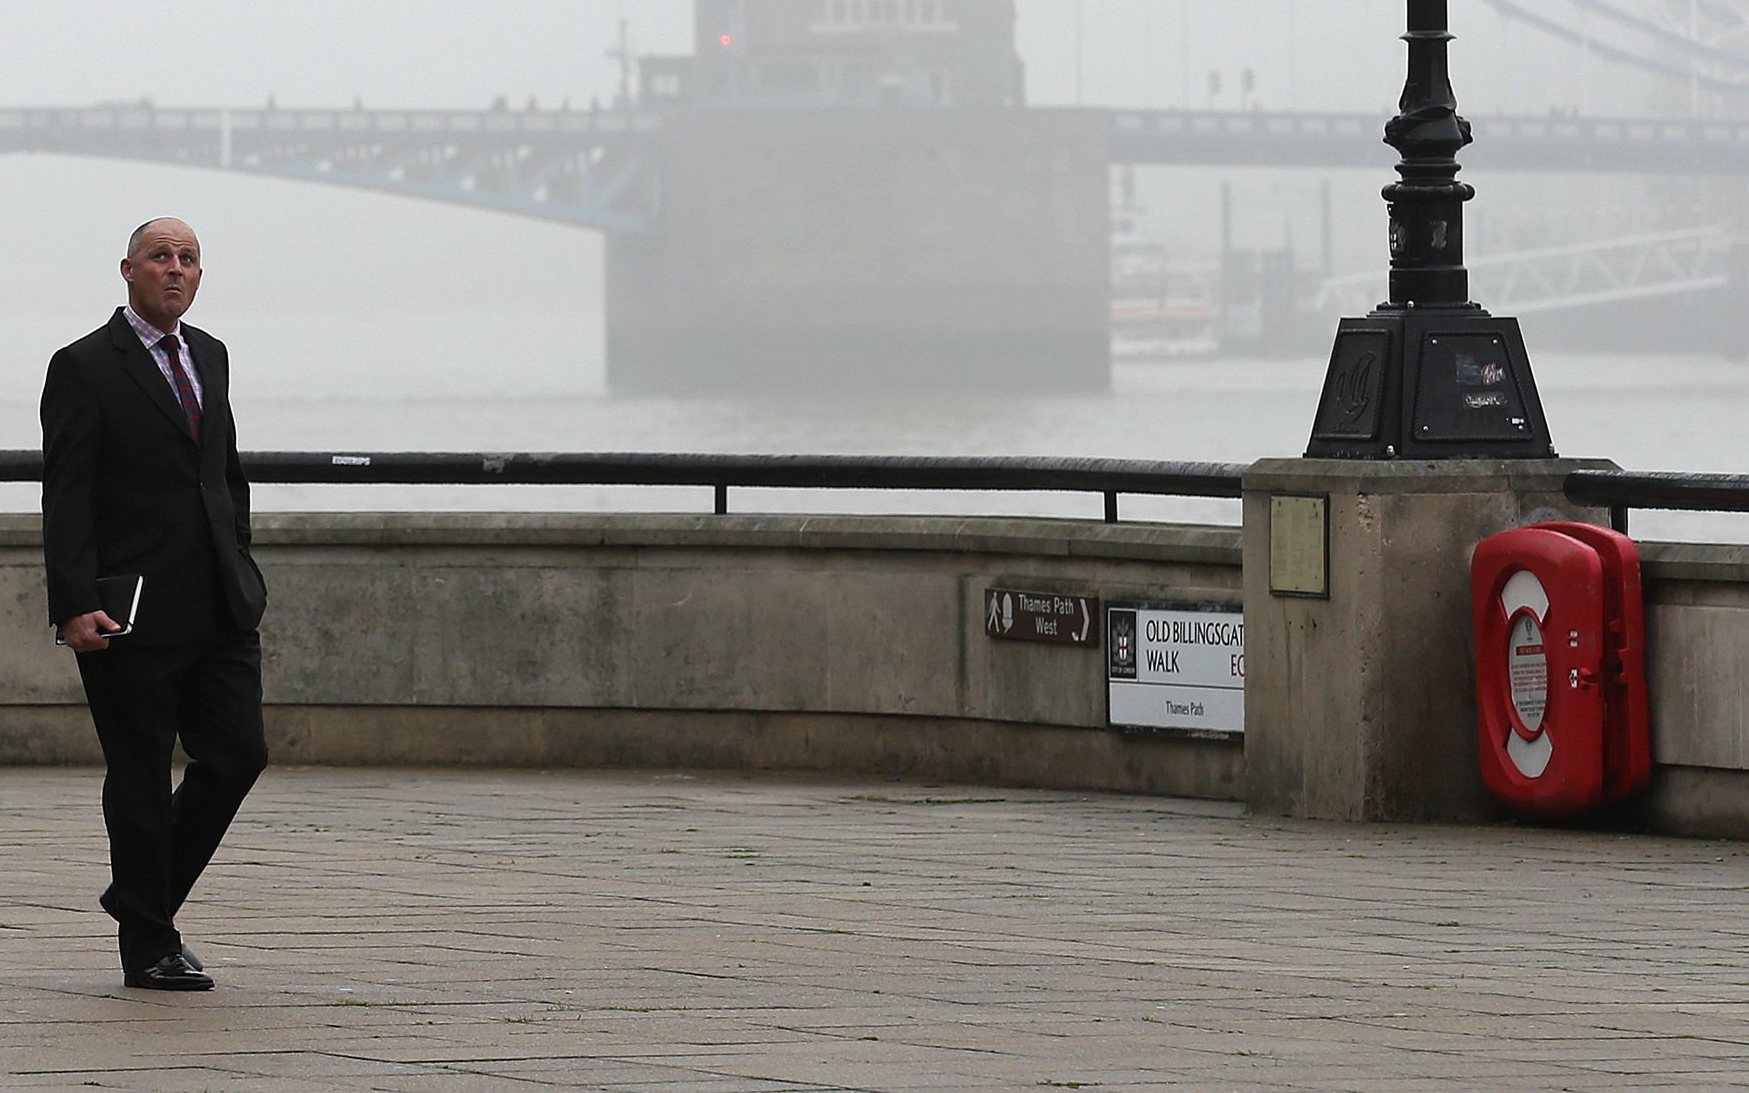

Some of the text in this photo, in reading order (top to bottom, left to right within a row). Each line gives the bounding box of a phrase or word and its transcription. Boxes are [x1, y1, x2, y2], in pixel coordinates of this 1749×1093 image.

[1019, 594, 1074, 615] Thames Path
[1035, 617, 1058, 635] West
[1146, 619, 1171, 643] OLD
[1146, 649, 1180, 674] WALK
[1166, 701, 1204, 716] Thames Path
